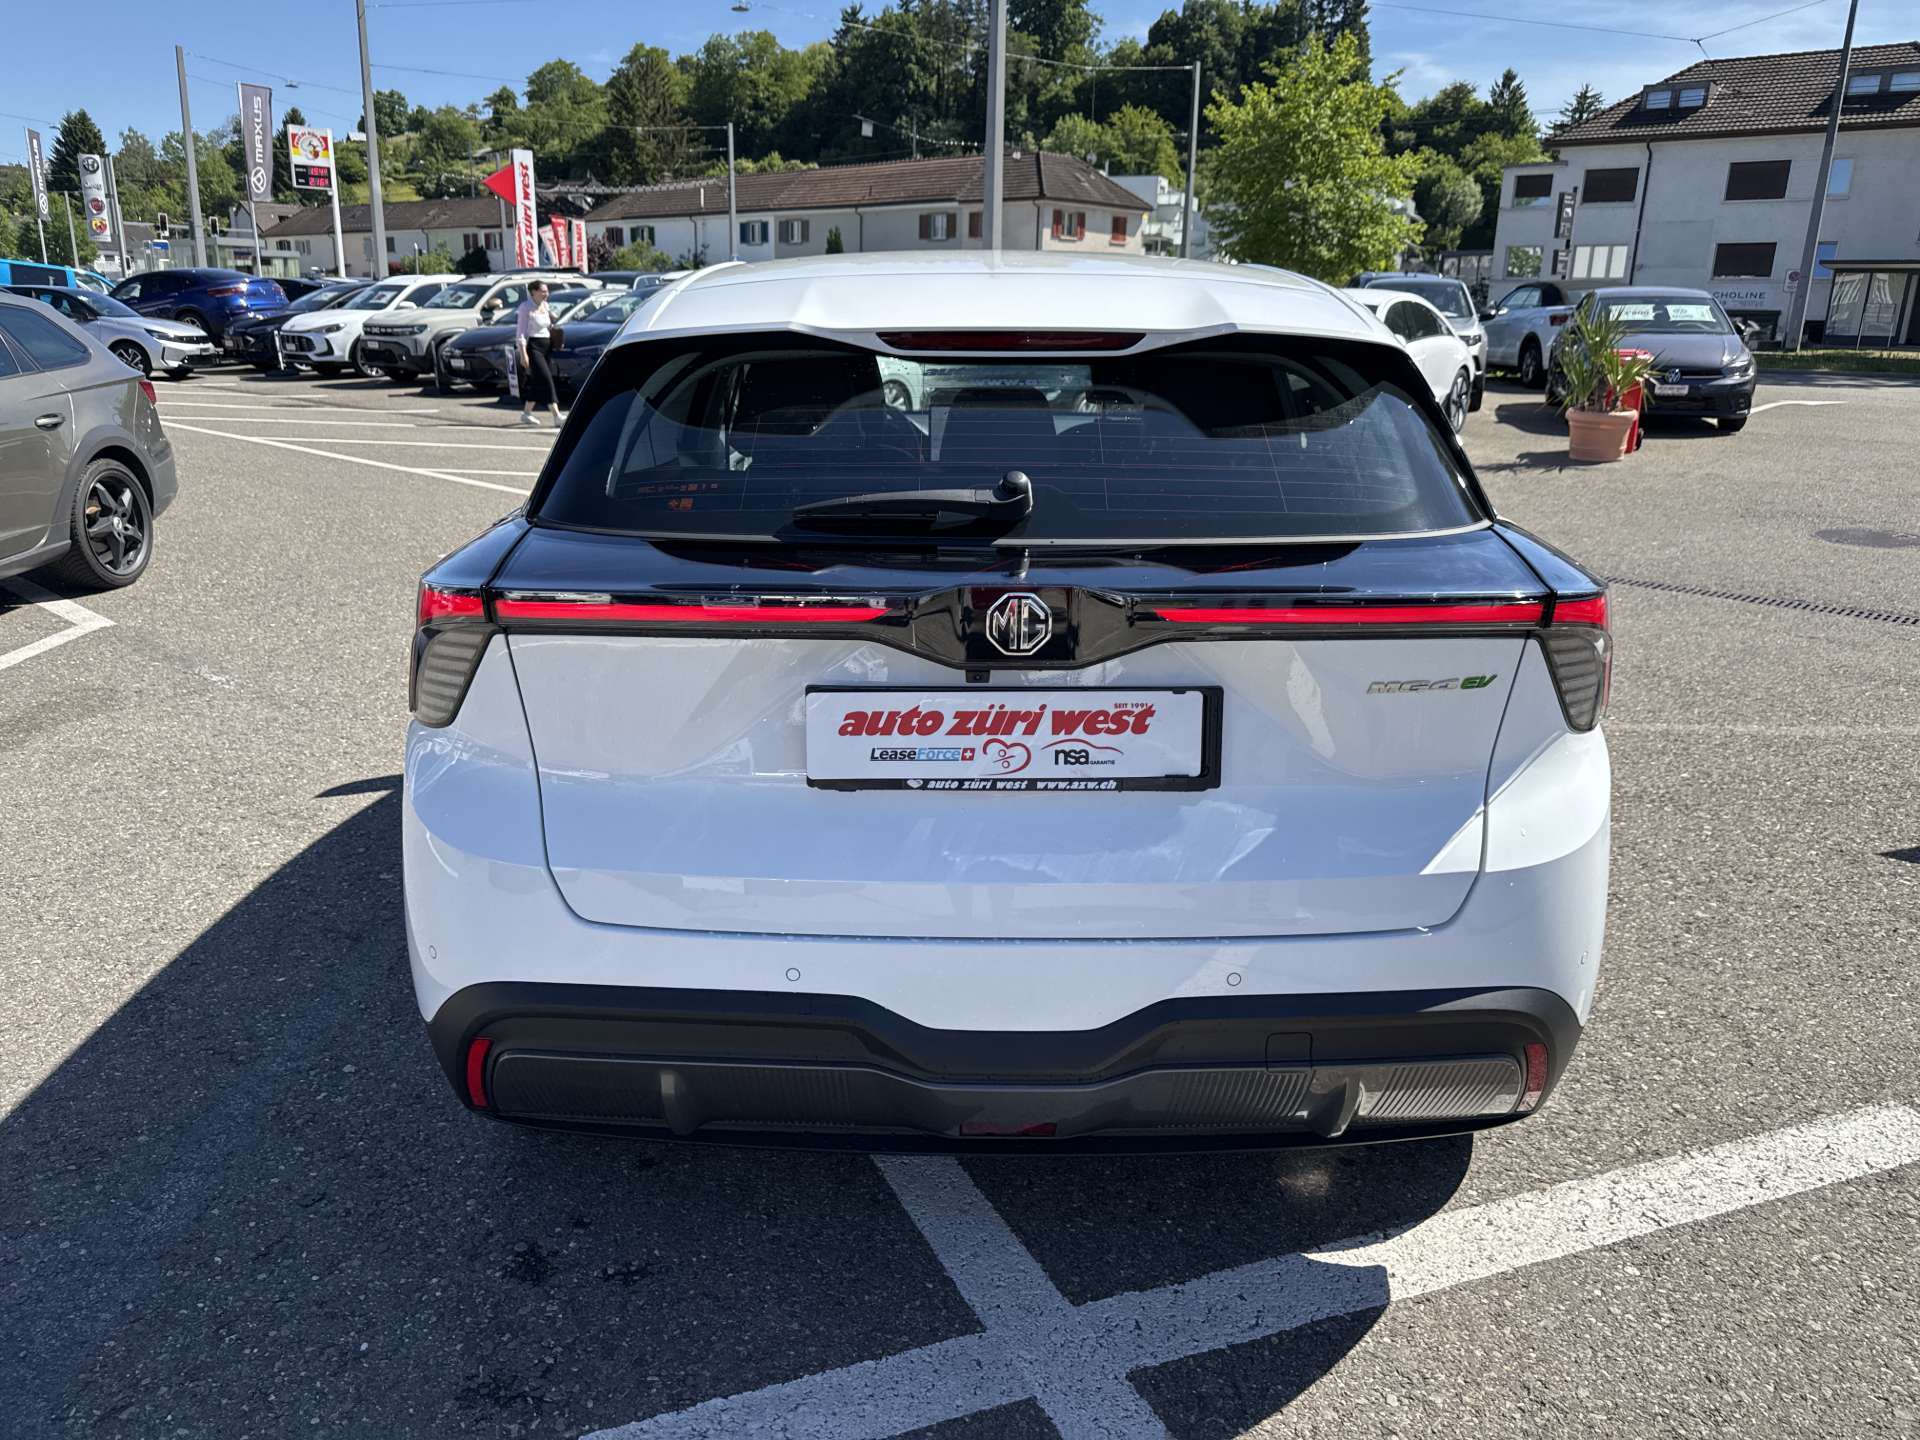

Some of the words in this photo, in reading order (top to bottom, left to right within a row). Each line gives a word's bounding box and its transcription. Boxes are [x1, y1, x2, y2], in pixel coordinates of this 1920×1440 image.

[253, 95, 264, 163] MAXUS
[33, 138, 45, 191] MAXUS
[519, 161, 531, 201] west
[521, 202, 534, 240] züri
[993, 598, 1046, 650] MG
[1460, 674, 1498, 690] EV
[838, 704, 944, 737] auto
[945, 703, 1047, 736] züri
[1052, 703, 1156, 736] west
[1130, 702, 1149, 710] 1991
[870, 747, 961, 761] LeaseForce
[1054, 749, 1090, 766] nsa
[927, 780, 960, 790] auto
[962, 779, 992, 790] züri
[996, 779, 1028, 790] west
[1036, 779, 1118, 790] www.azw.ch
